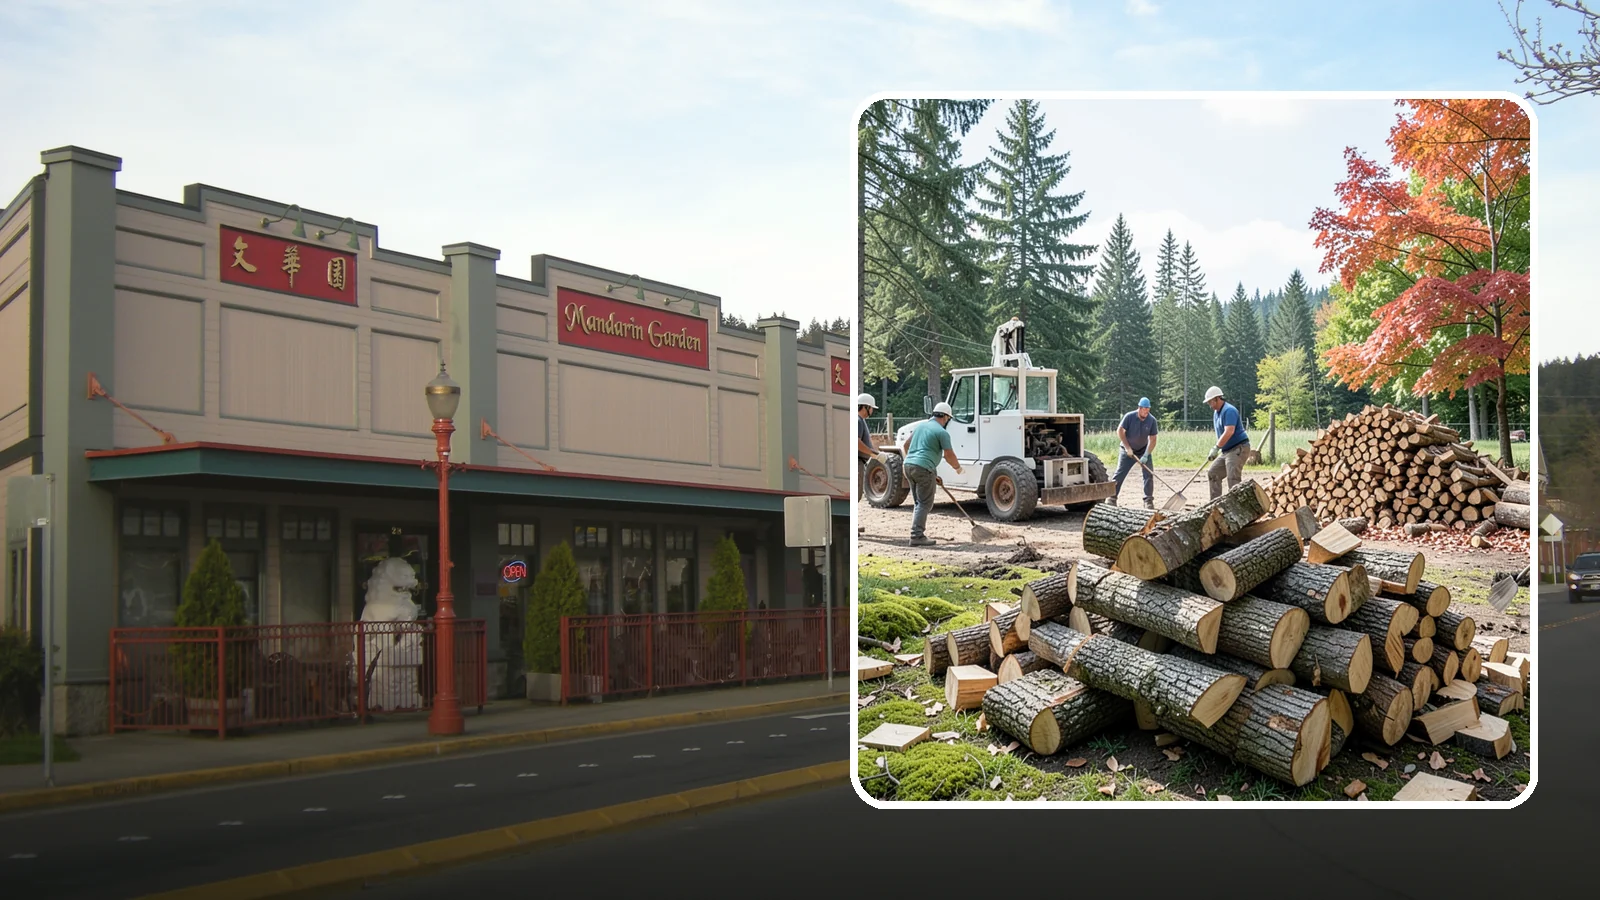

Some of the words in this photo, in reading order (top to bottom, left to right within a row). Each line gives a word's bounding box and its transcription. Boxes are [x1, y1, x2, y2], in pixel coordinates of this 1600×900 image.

[231, 236, 346, 291] 文華園
[565, 302, 644, 341] Mandarin
[648, 320, 702, 352] Garden
[503, 565, 527, 578] OPEN
